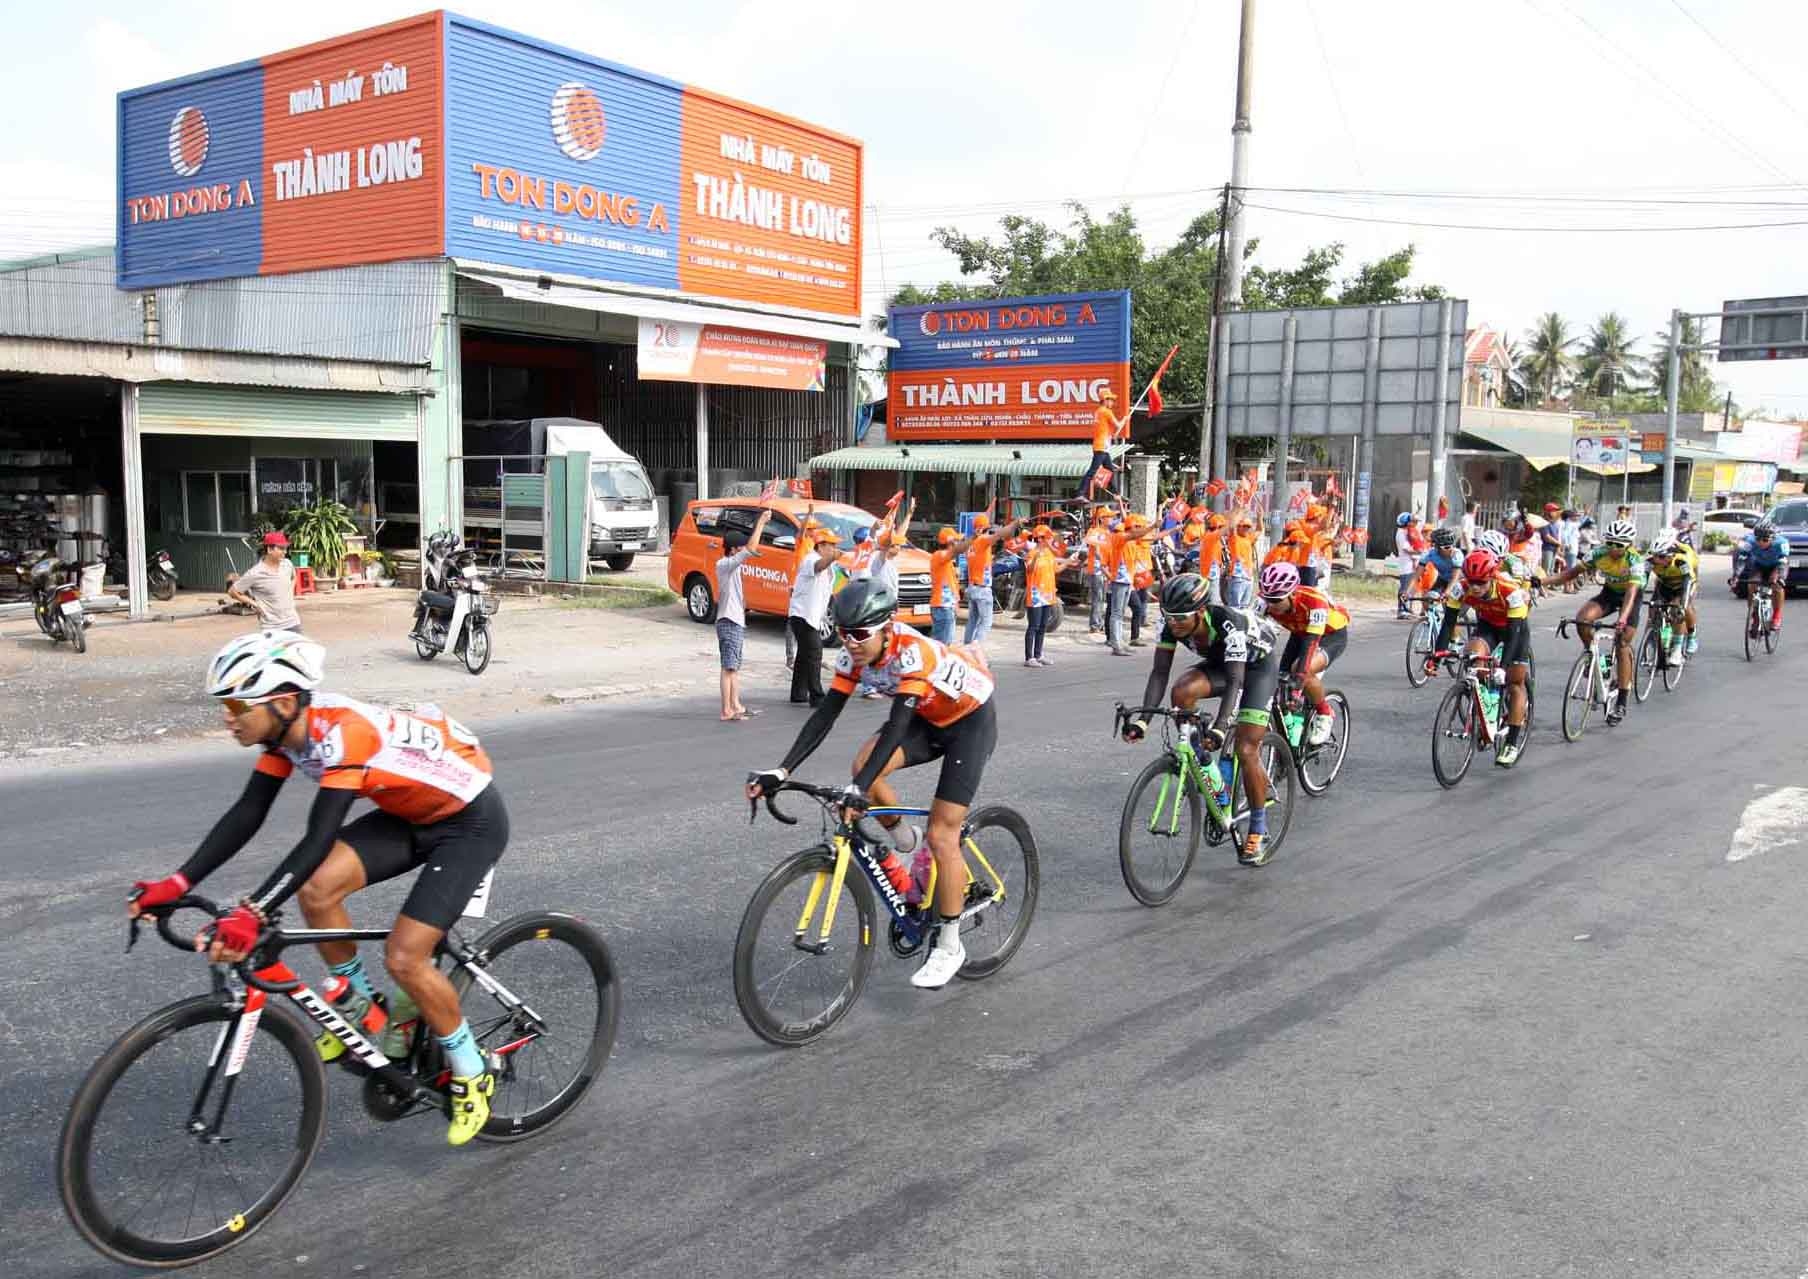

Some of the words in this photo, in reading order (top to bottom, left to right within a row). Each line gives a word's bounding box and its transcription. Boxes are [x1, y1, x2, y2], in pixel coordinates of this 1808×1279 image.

[289, 80, 324, 116] NHÀ
[329, 70, 364, 108] MÁY
[371, 62, 407, 97] TÔN
[272, 148, 350, 201] THÀNH
[357, 137, 422, 187] LONG
[720, 133, 755, 165] NHÀ
[761, 142, 794, 175] MÁY
[801, 151, 831, 185] TÔN
[236, 179, 255, 208] A
[692, 171, 784, 231] THÀNH
[789, 196, 851, 247] LONG
[646, 202, 669, 234] A
[944, 311, 989, 332] TON
[998, 305, 1066, 329] DONG
[1077, 303, 1097, 325] A
[902, 378, 1005, 407] THÀNH
[1021, 378, 1110, 404] LONG
[780, 571, 789, 584] A
[943, 660, 967, 692] 13
[401, 713, 439, 752] 15
[859, 845, 906, 917] S-WORKS
